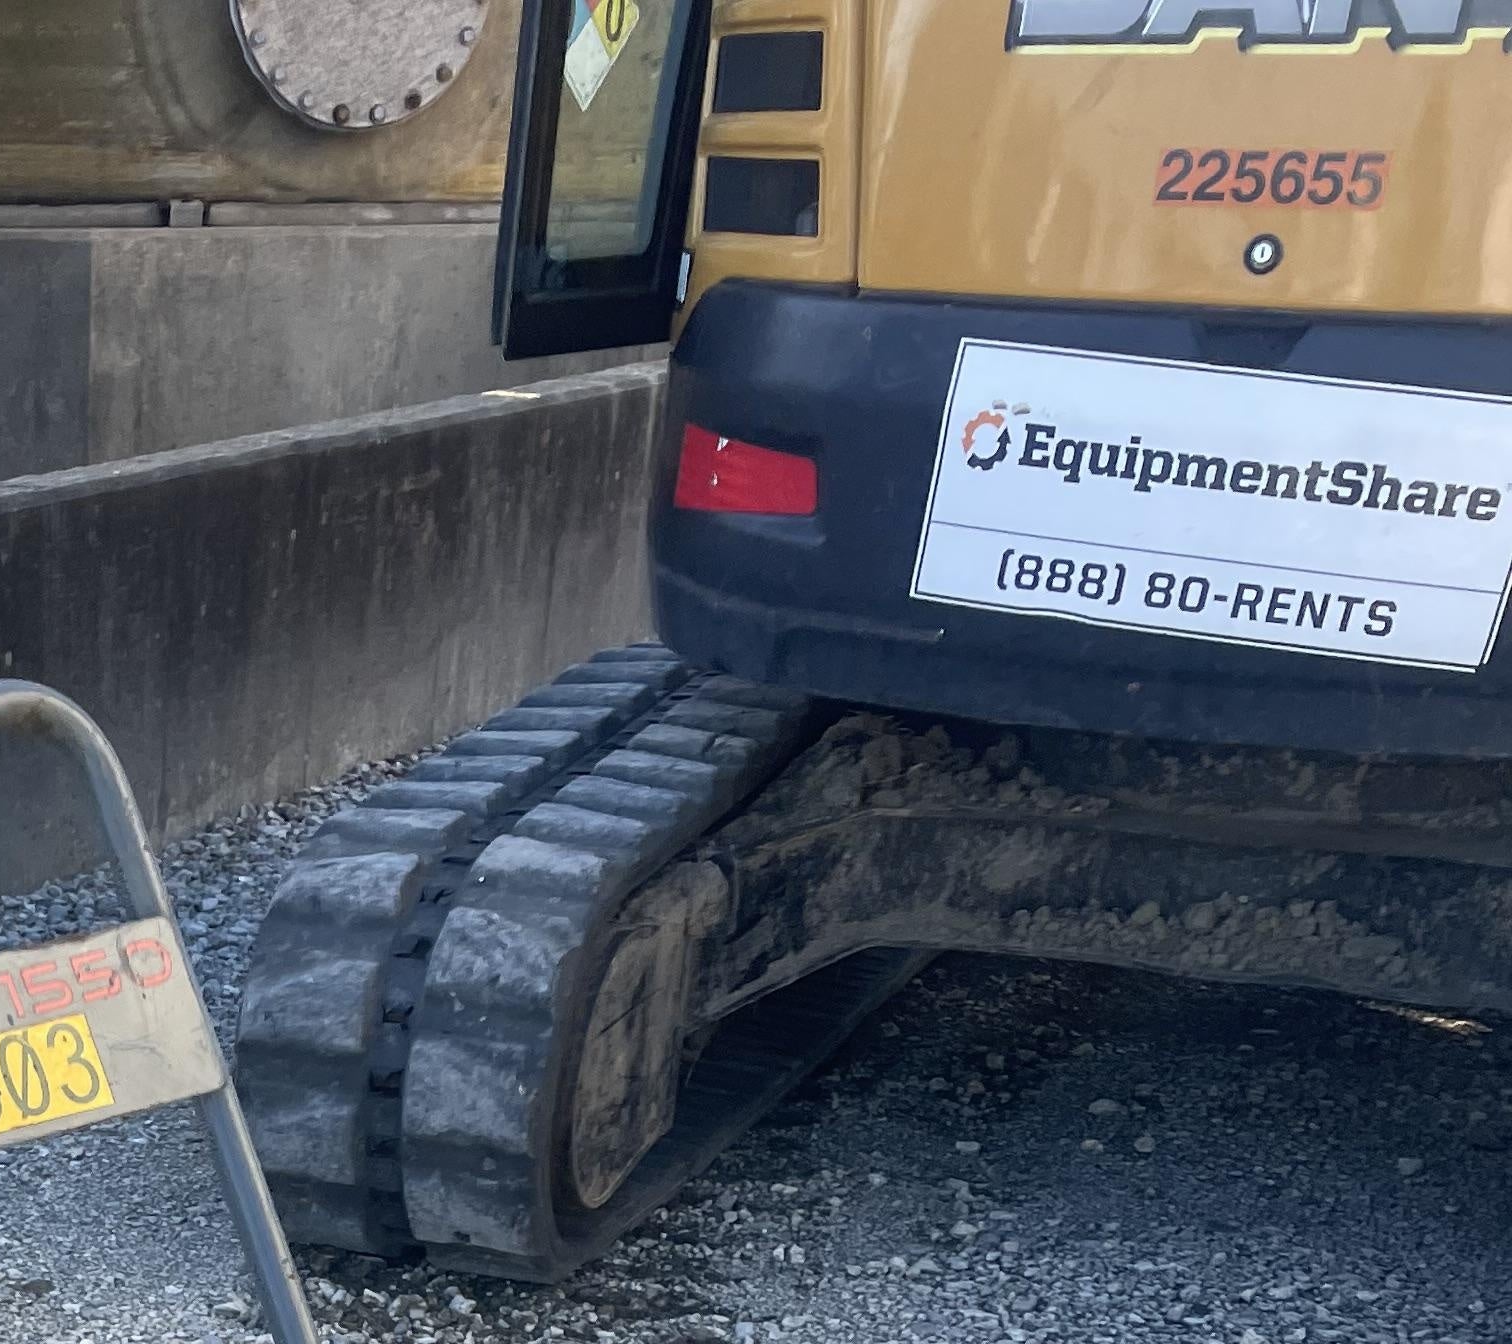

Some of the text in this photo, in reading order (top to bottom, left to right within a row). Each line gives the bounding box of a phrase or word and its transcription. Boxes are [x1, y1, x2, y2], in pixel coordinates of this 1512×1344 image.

[1156, 148, 1387, 206] 225655
[1018, 422, 1501, 522] EquipmentShare
[996, 548, 1399, 638] (888) 80-RENTS
